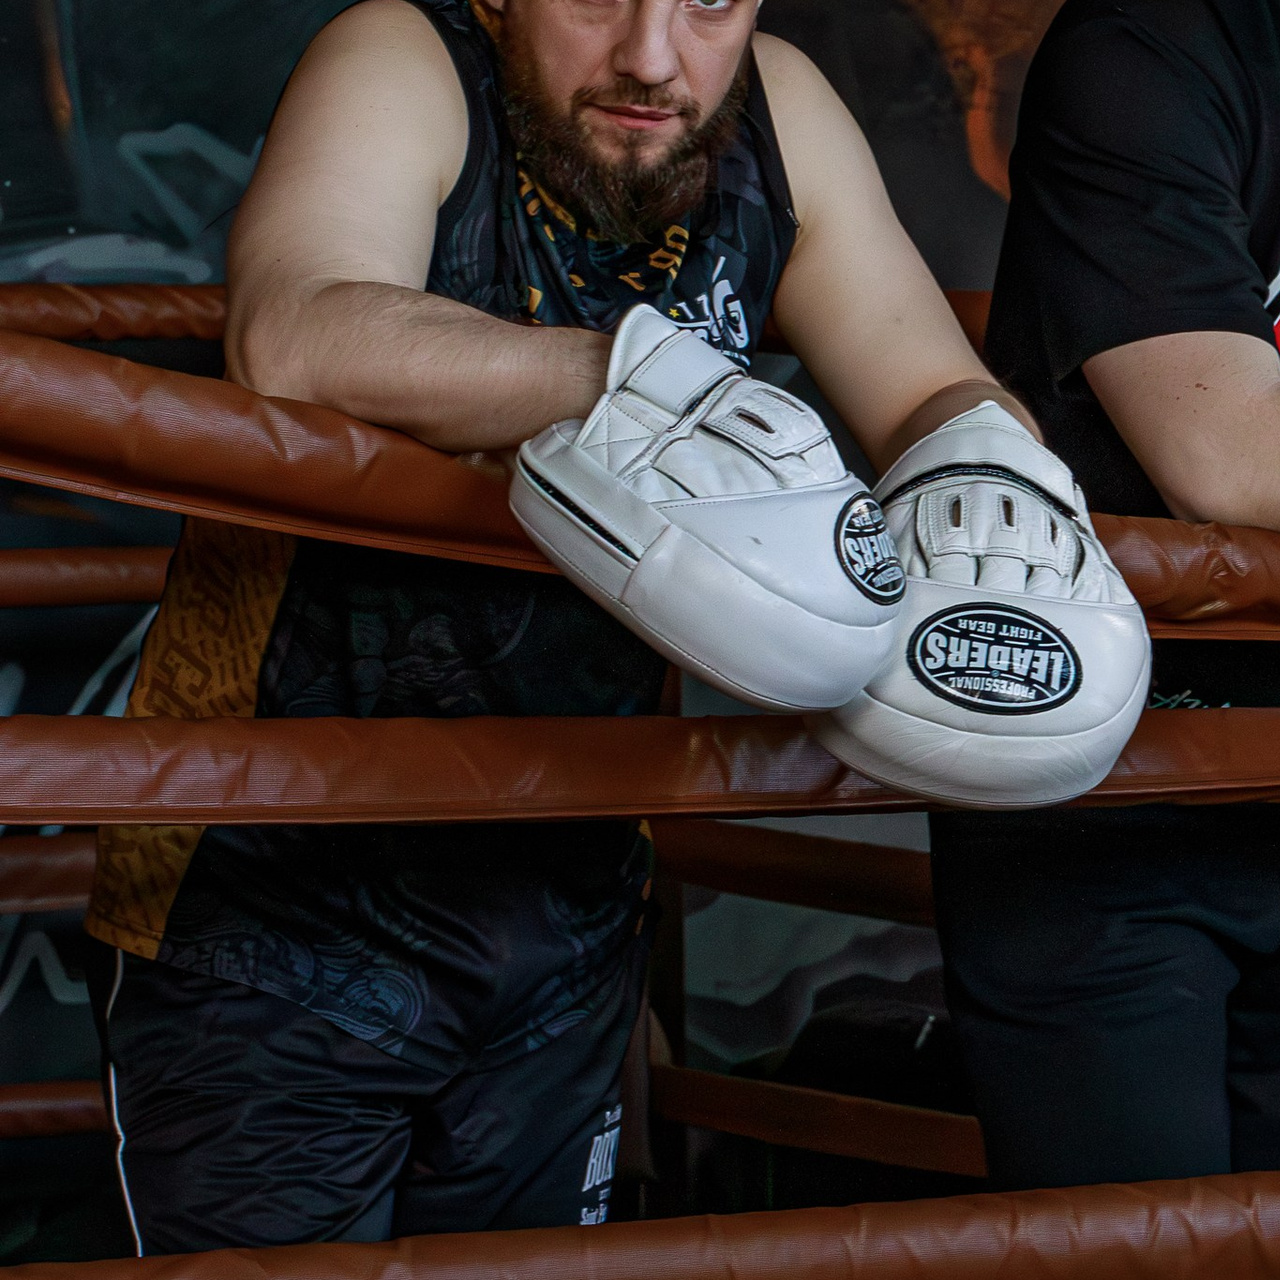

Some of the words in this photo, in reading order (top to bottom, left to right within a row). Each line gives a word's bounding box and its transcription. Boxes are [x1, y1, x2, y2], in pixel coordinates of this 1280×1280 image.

[957, 618, 996, 634] GEAR
[998, 624, 1043, 641] FIGHT
[924, 630, 1065, 691] LEADERS
[948, 676, 1037, 700] PROFESSIONAL
